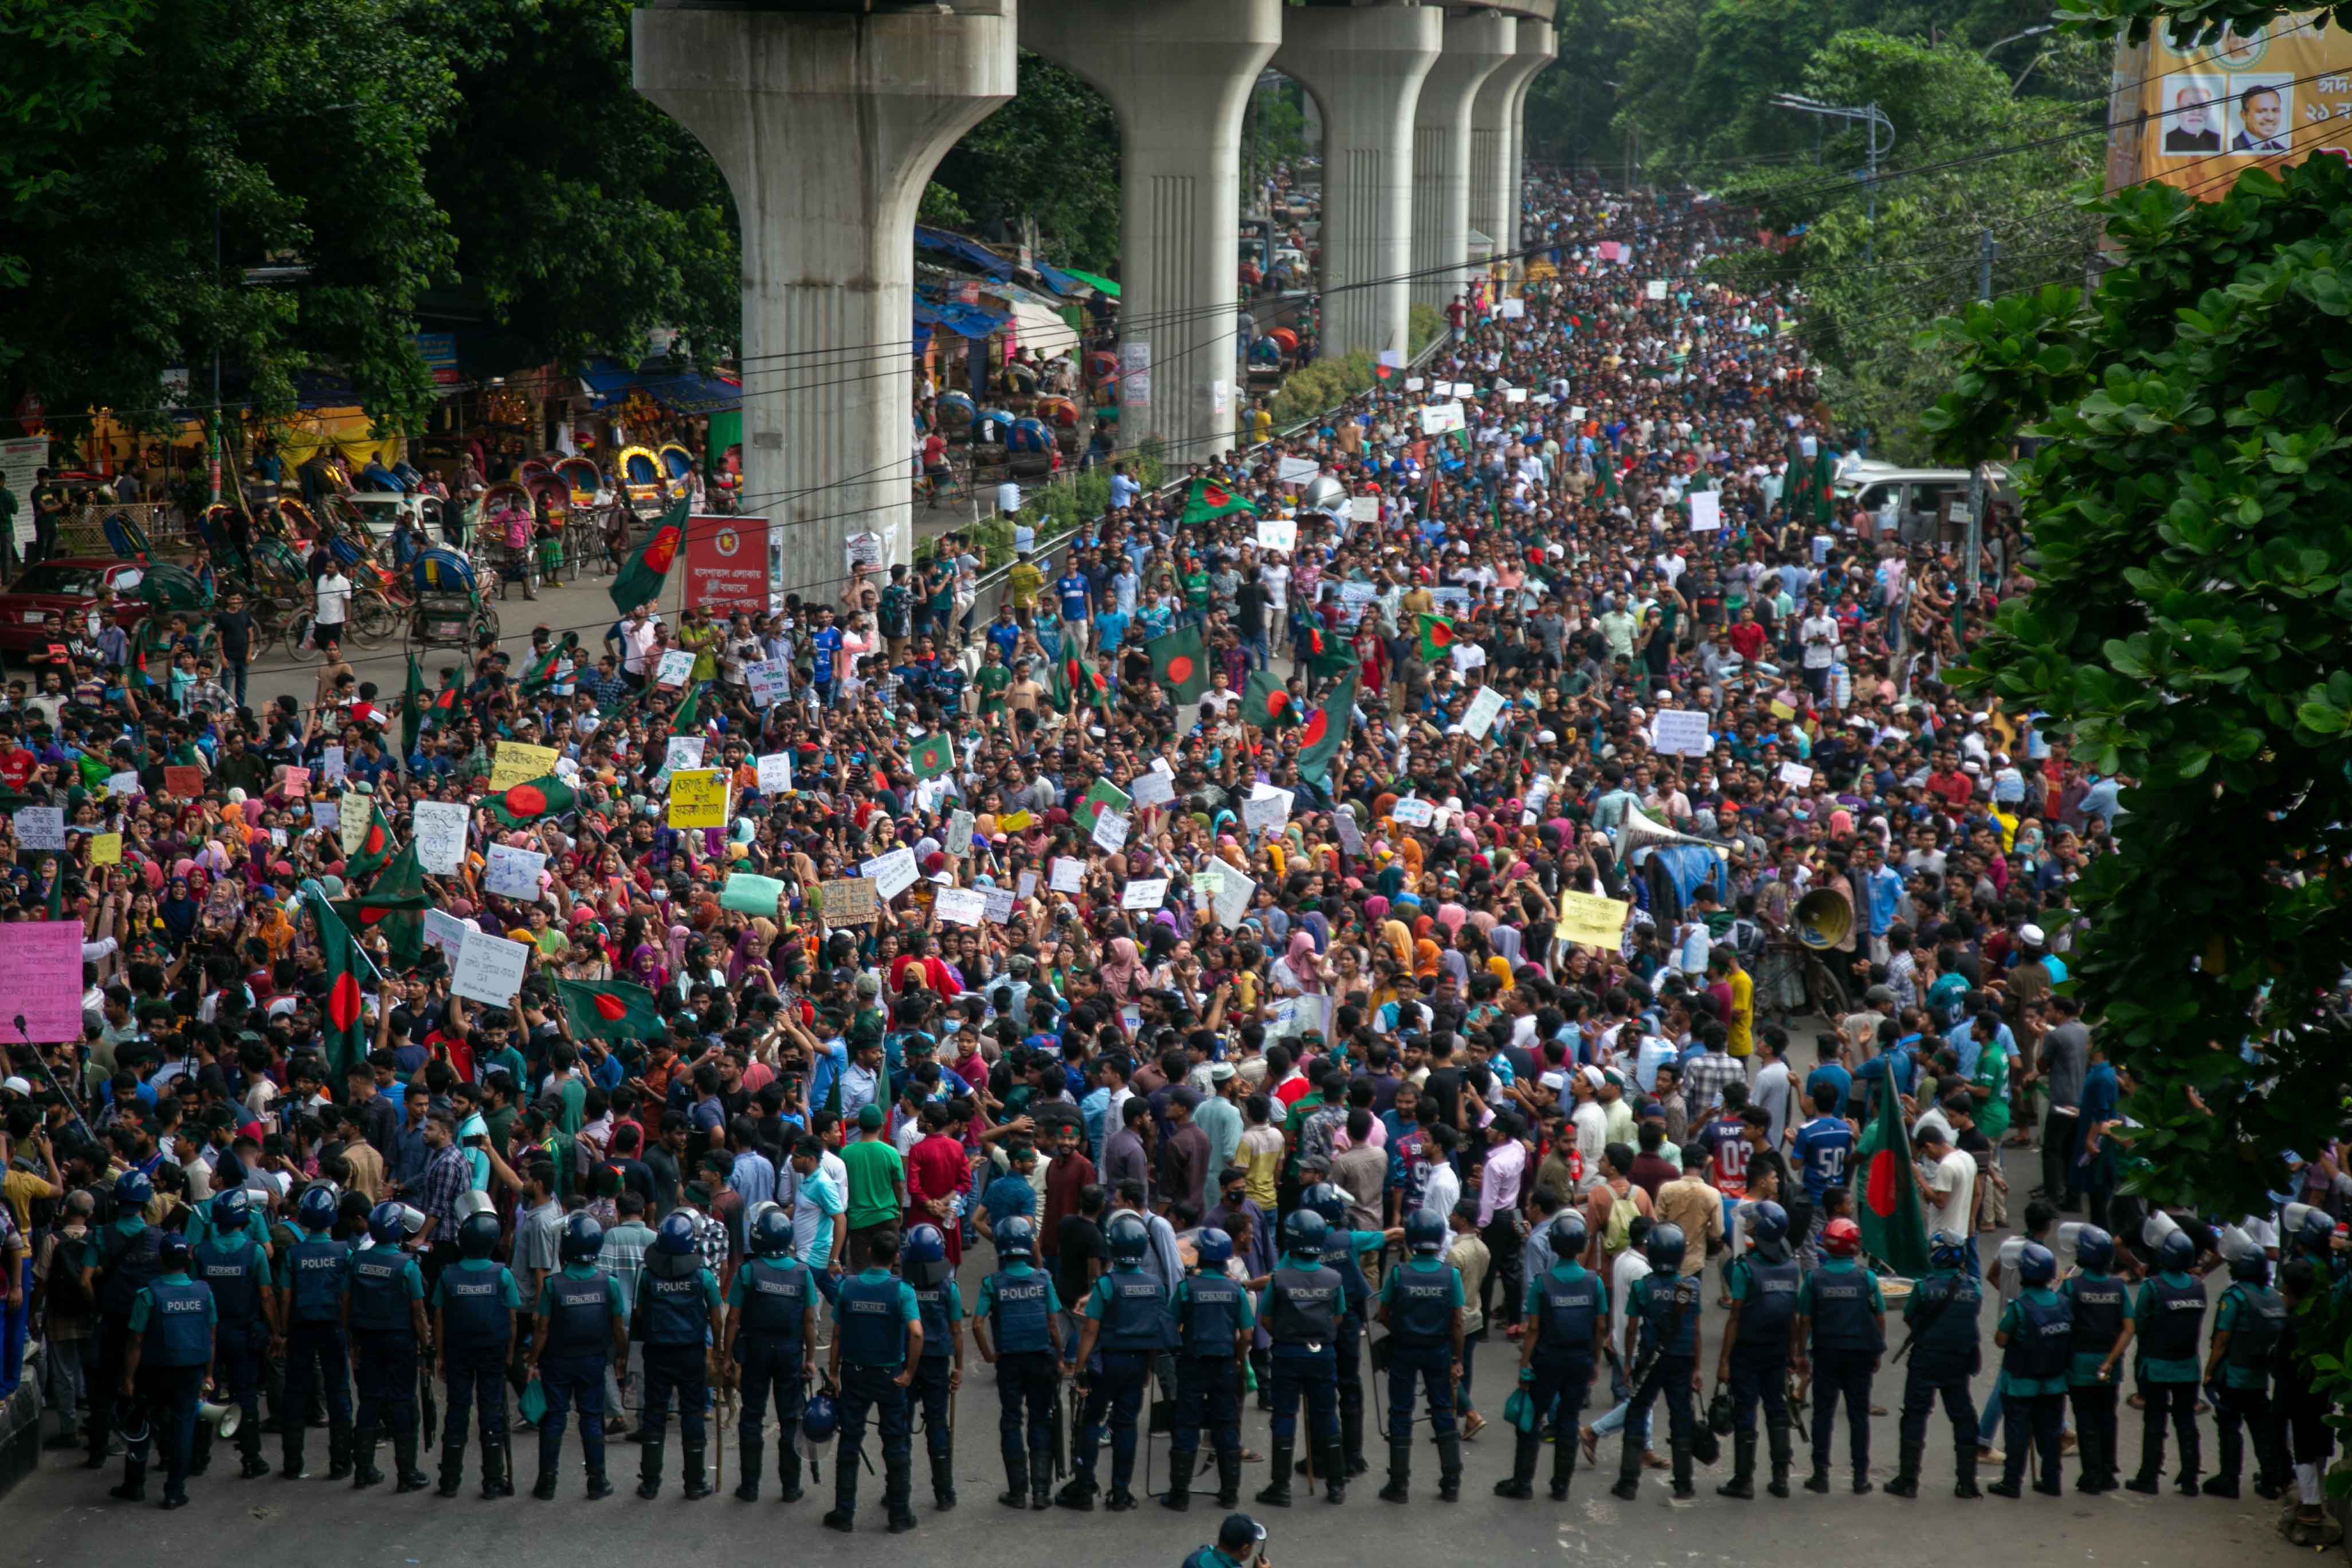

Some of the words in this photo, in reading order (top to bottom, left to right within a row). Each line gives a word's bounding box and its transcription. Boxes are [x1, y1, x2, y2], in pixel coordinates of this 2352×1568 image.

[2306, 103, 2330, 120] ২১
[693, 568, 730, 578] হাসপাতাল
[733, 570, 762, 579] এলাকায়
[719, 584, 748, 593] বাজানো
[1722, 1139, 1754, 1177] 03
[1817, 1147, 1846, 1177] 50
[1318, 1249, 1348, 1264] OLICE
[301, 1257, 336, 1269] POLICE
[362, 1265, 387, 1275] POLICE
[657, 1281, 691, 1292] POLICE
[1410, 1287, 1442, 1296] POLICE
[999, 1285, 1045, 1302] POLICE
[1202, 1292, 1229, 1300] POLICE
[1289, 1288, 1330, 1298] POLICE
[167, 1300, 202, 1311] POLICE
[569, 1296, 596, 1304] POLICE
